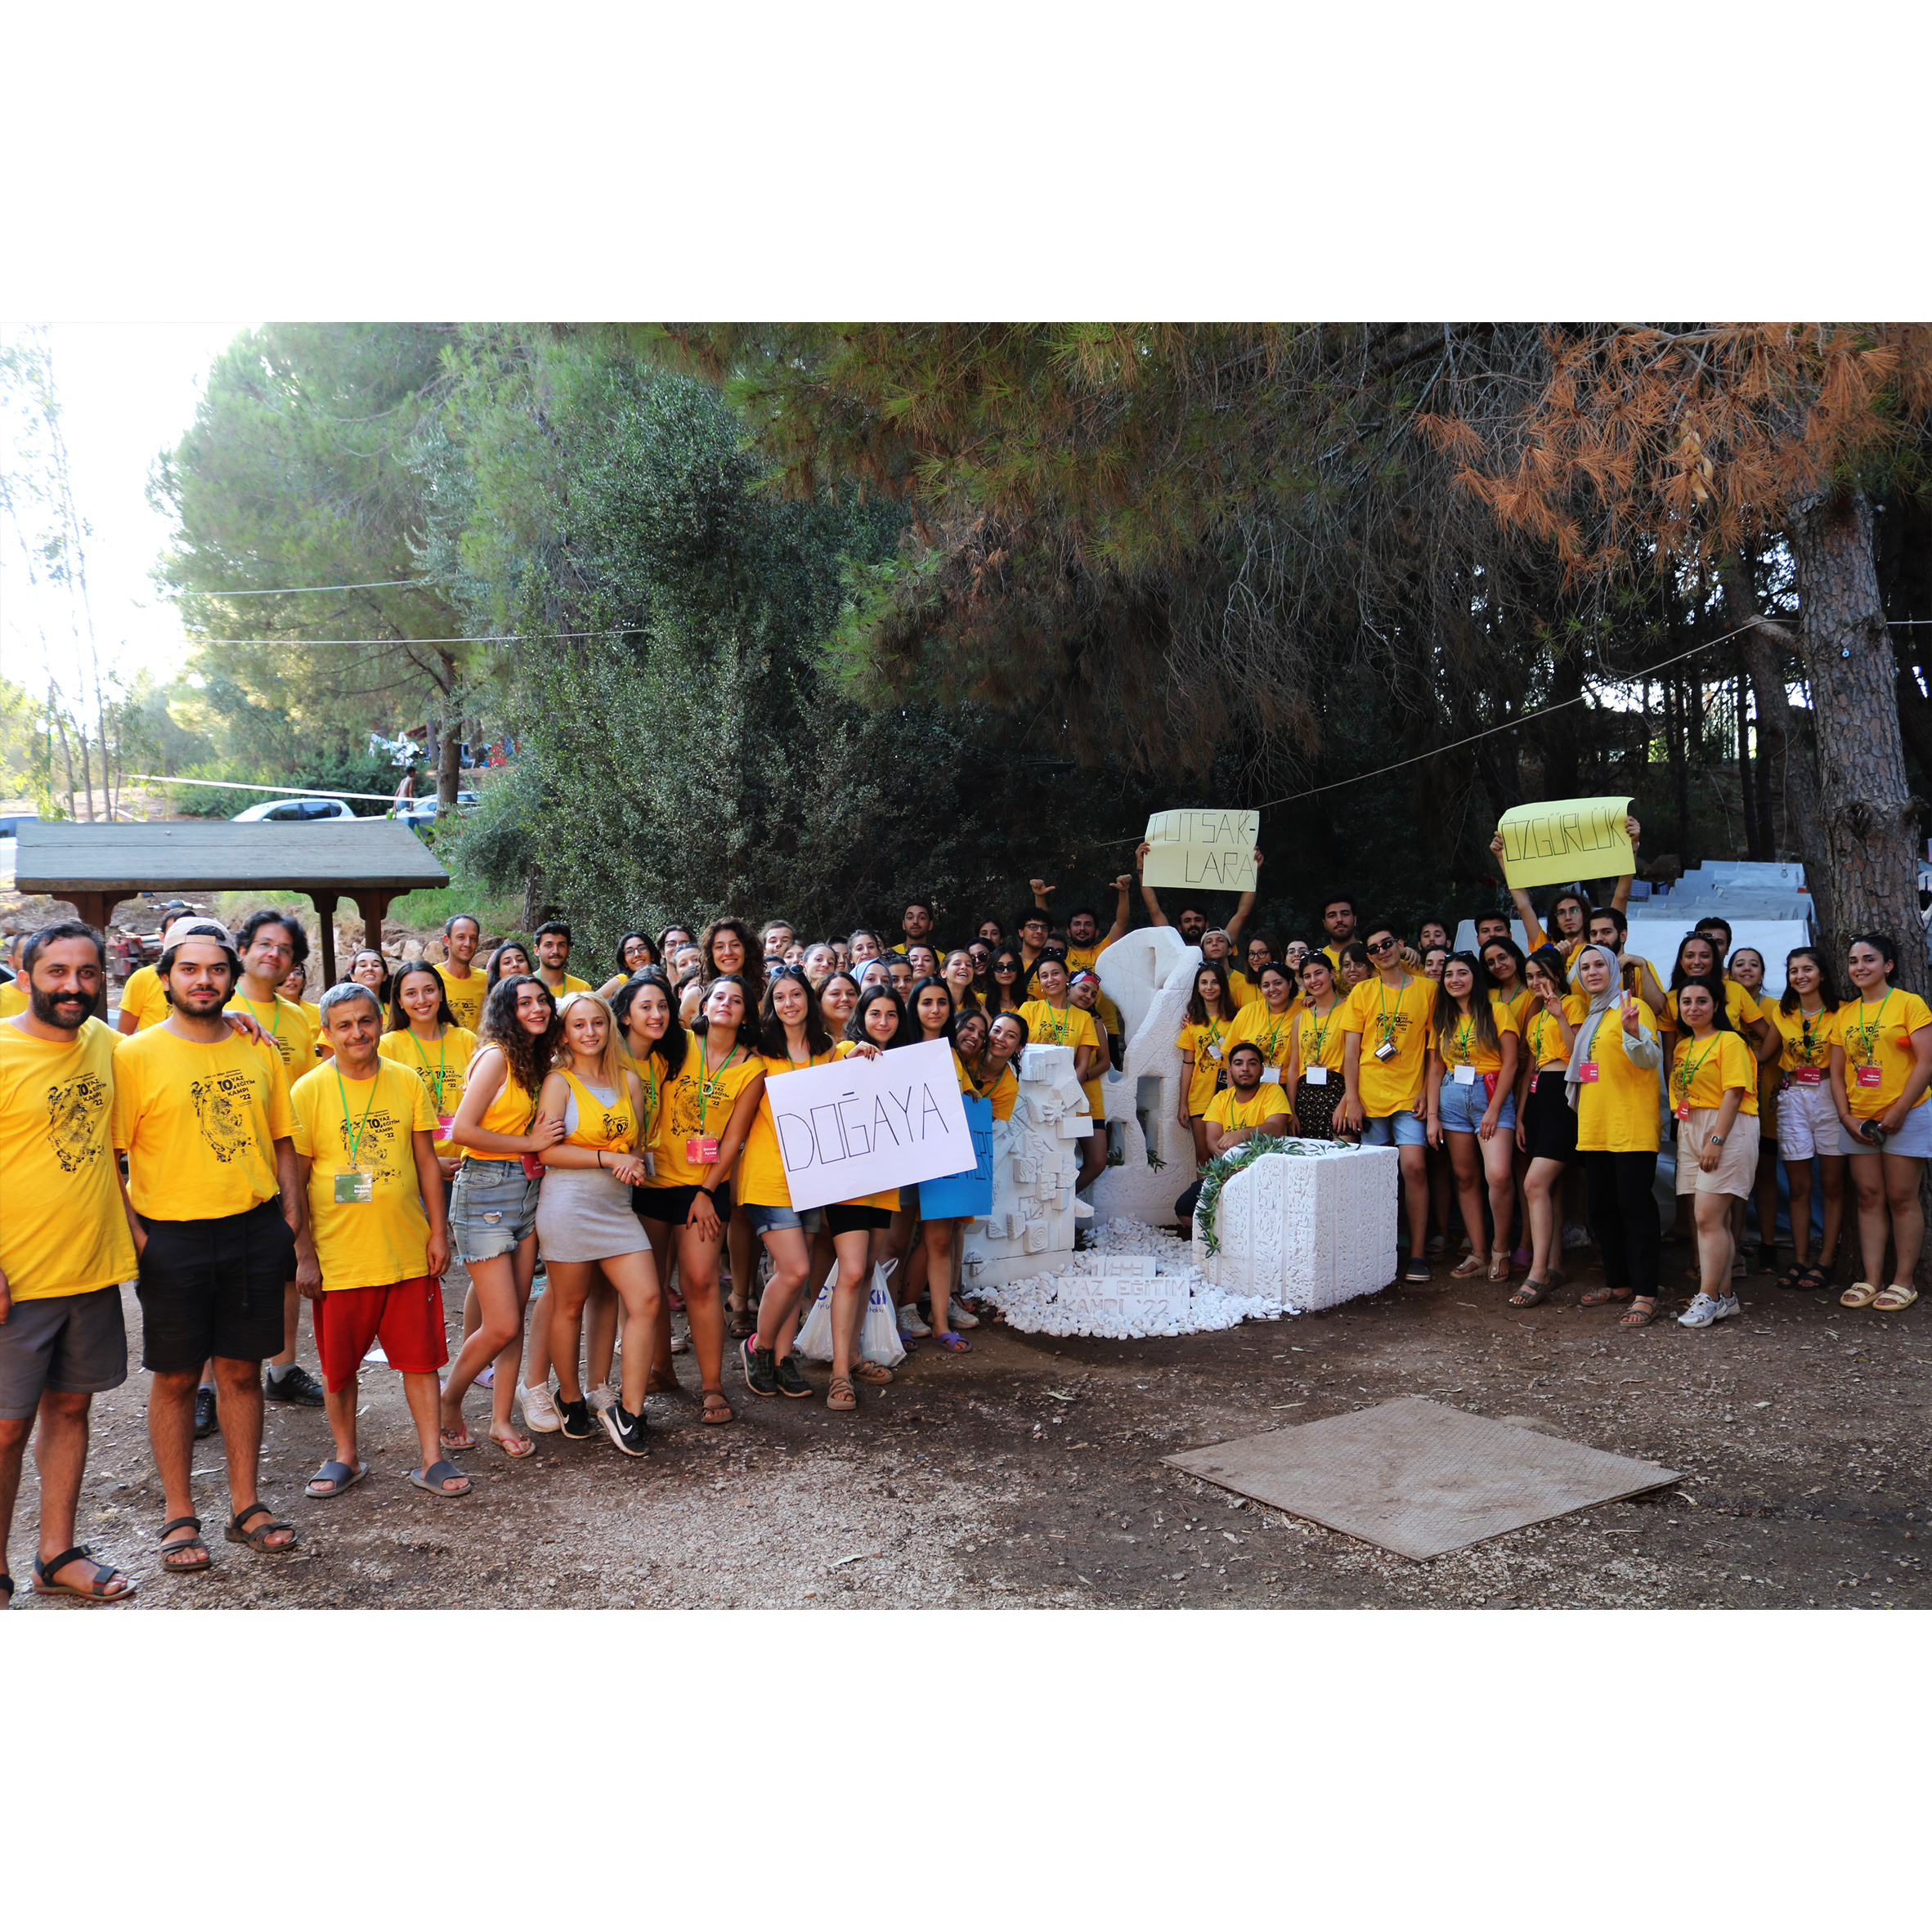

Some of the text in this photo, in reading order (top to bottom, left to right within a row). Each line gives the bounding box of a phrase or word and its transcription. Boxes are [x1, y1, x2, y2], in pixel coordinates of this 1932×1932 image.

[1150, 812, 1257, 845] TUTSAK-
[1501, 805, 1626, 863] ÖZGÜRLÜK
[1185, 850, 1257, 885] LARA
[86, 1078, 99, 1087] YAZ
[236, 1078, 256, 1087] EĞİTİM
[83, 1092, 102, 1102] KAMPI
[227, 1087, 249, 1097] KAMPI
[776, 1082, 950, 1172] DOĞAYA
[1064, 1280, 1104, 1297] YAZ
[1062, 1298, 1124, 1316] KAMPI
